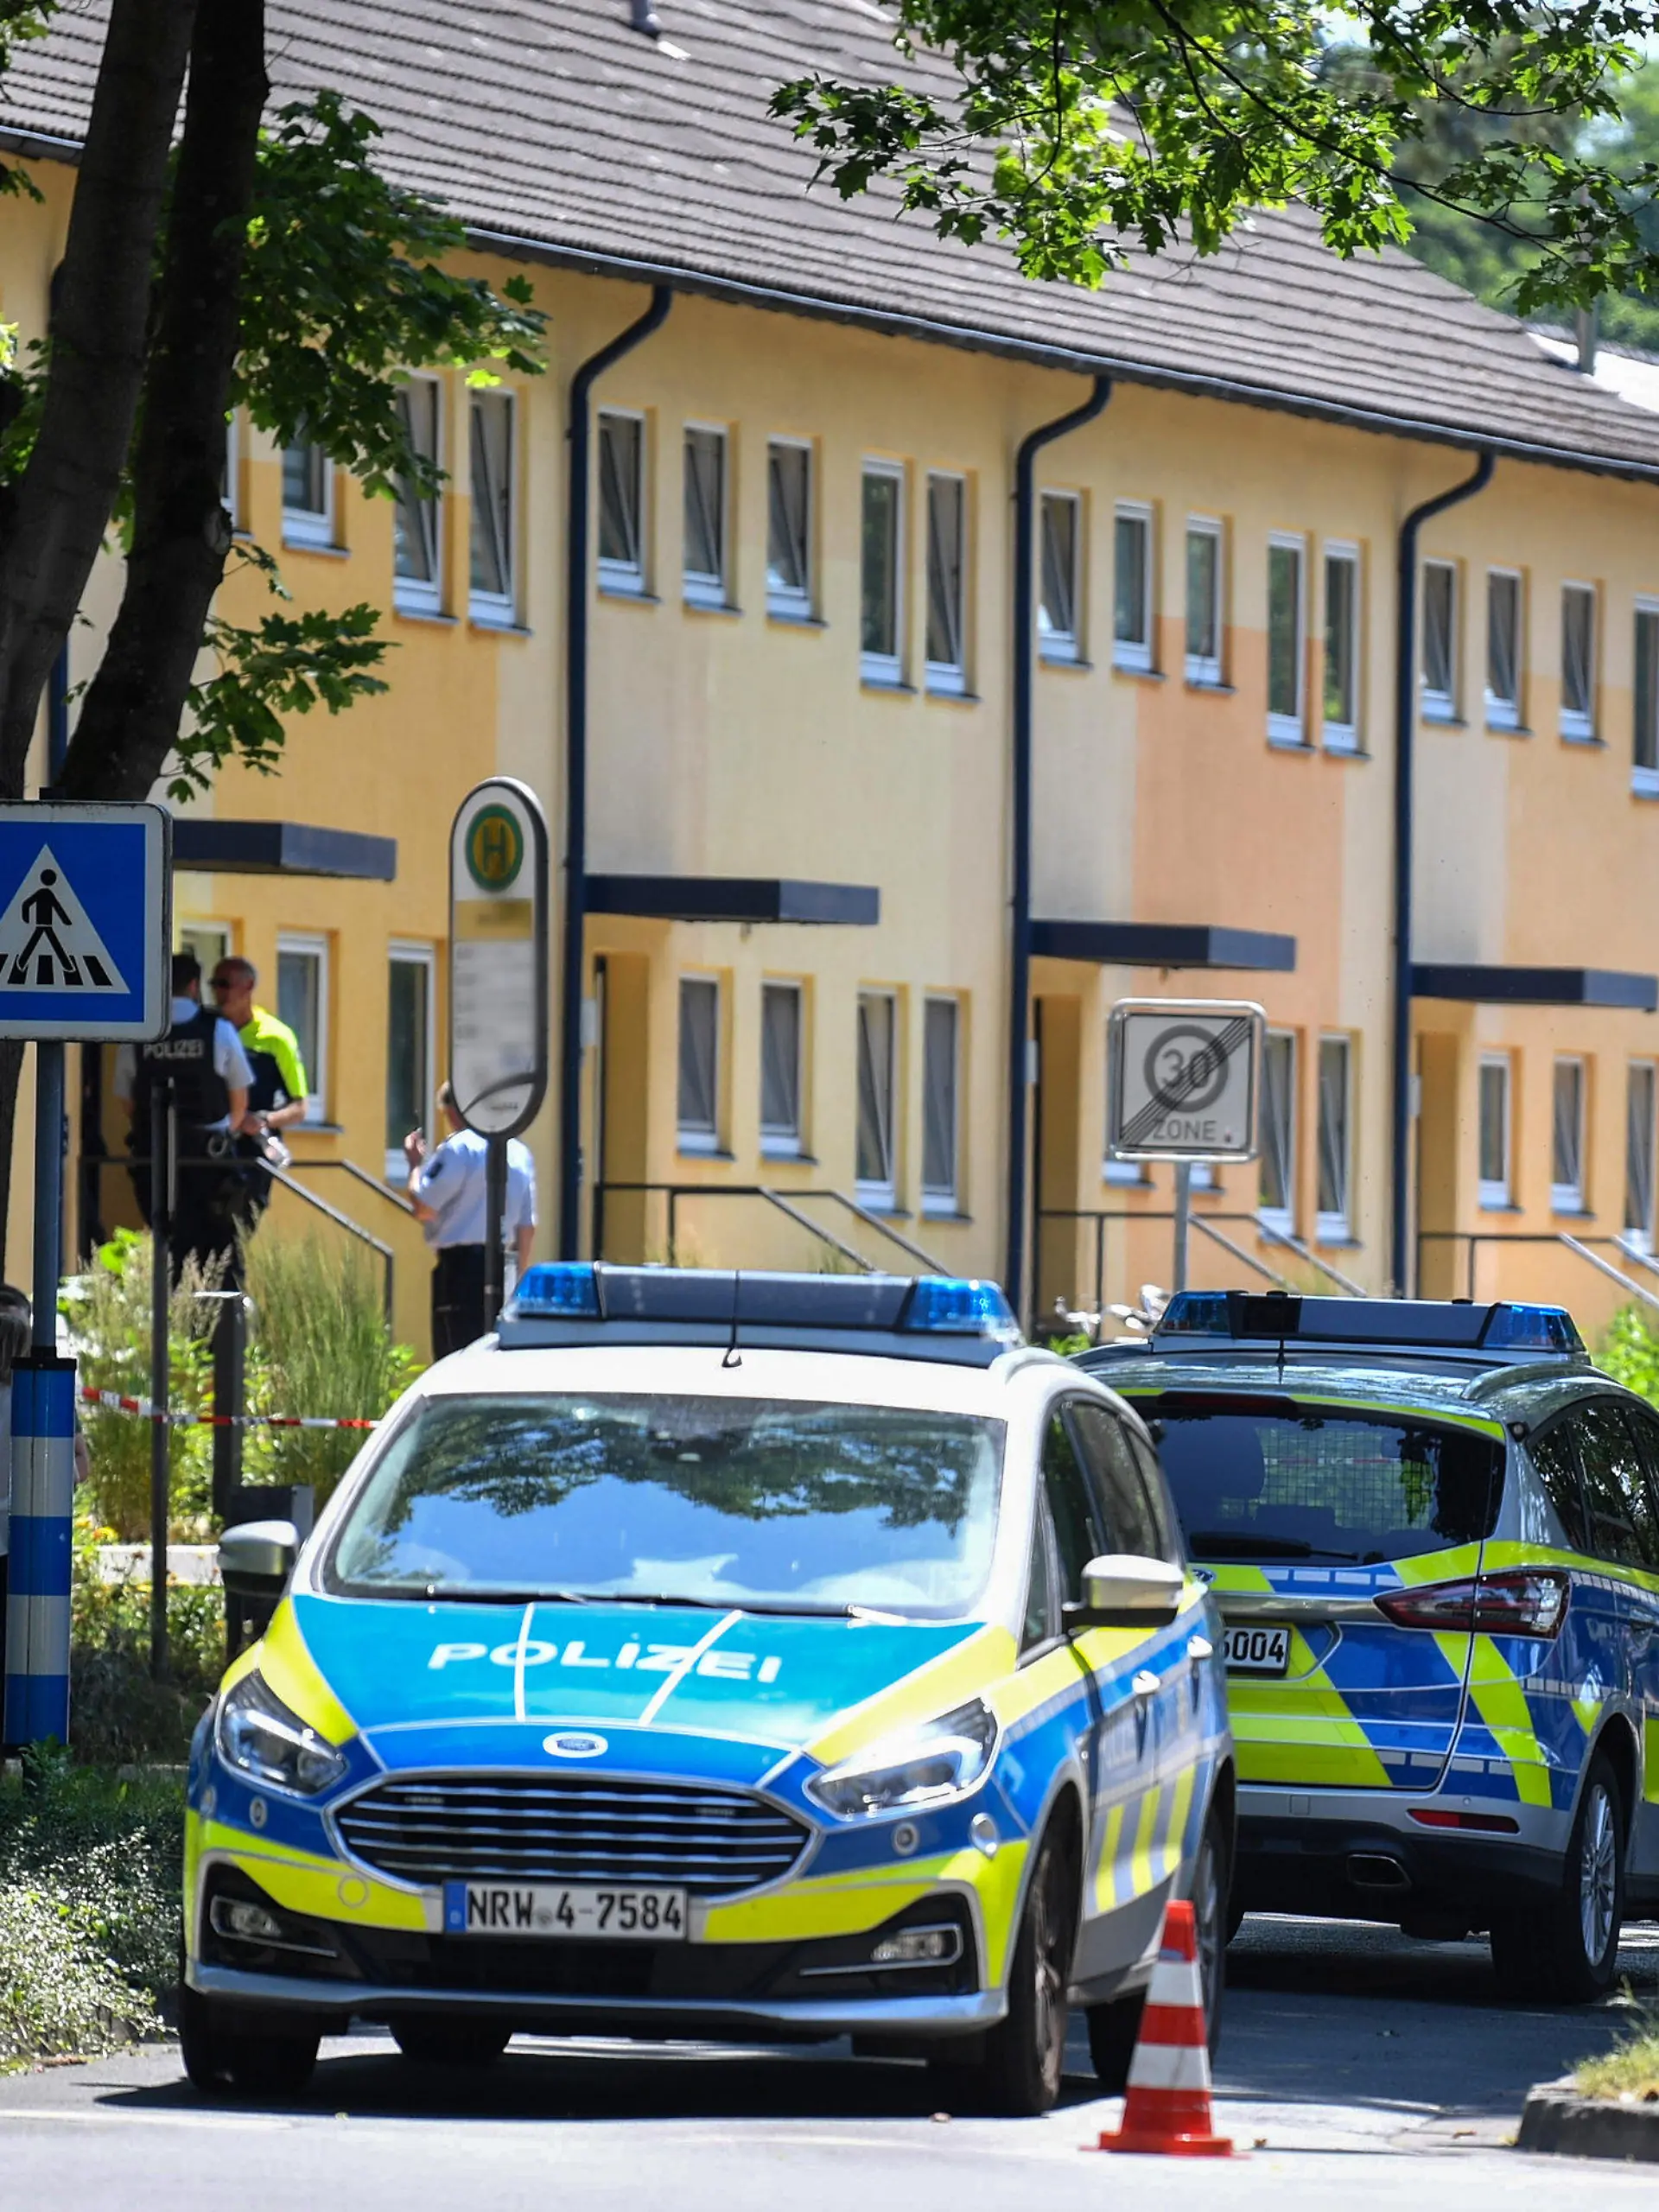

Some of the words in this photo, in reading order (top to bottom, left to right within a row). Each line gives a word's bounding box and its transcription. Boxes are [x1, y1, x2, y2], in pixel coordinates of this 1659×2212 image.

[482, 823, 508, 874] H
[143, 1039, 204, 1059] POLIZEI
[1161, 1048, 1212, 1089] 30
[1152, 1119, 1217, 1141] ZONE
[467, 1890, 533, 1928] NRW
